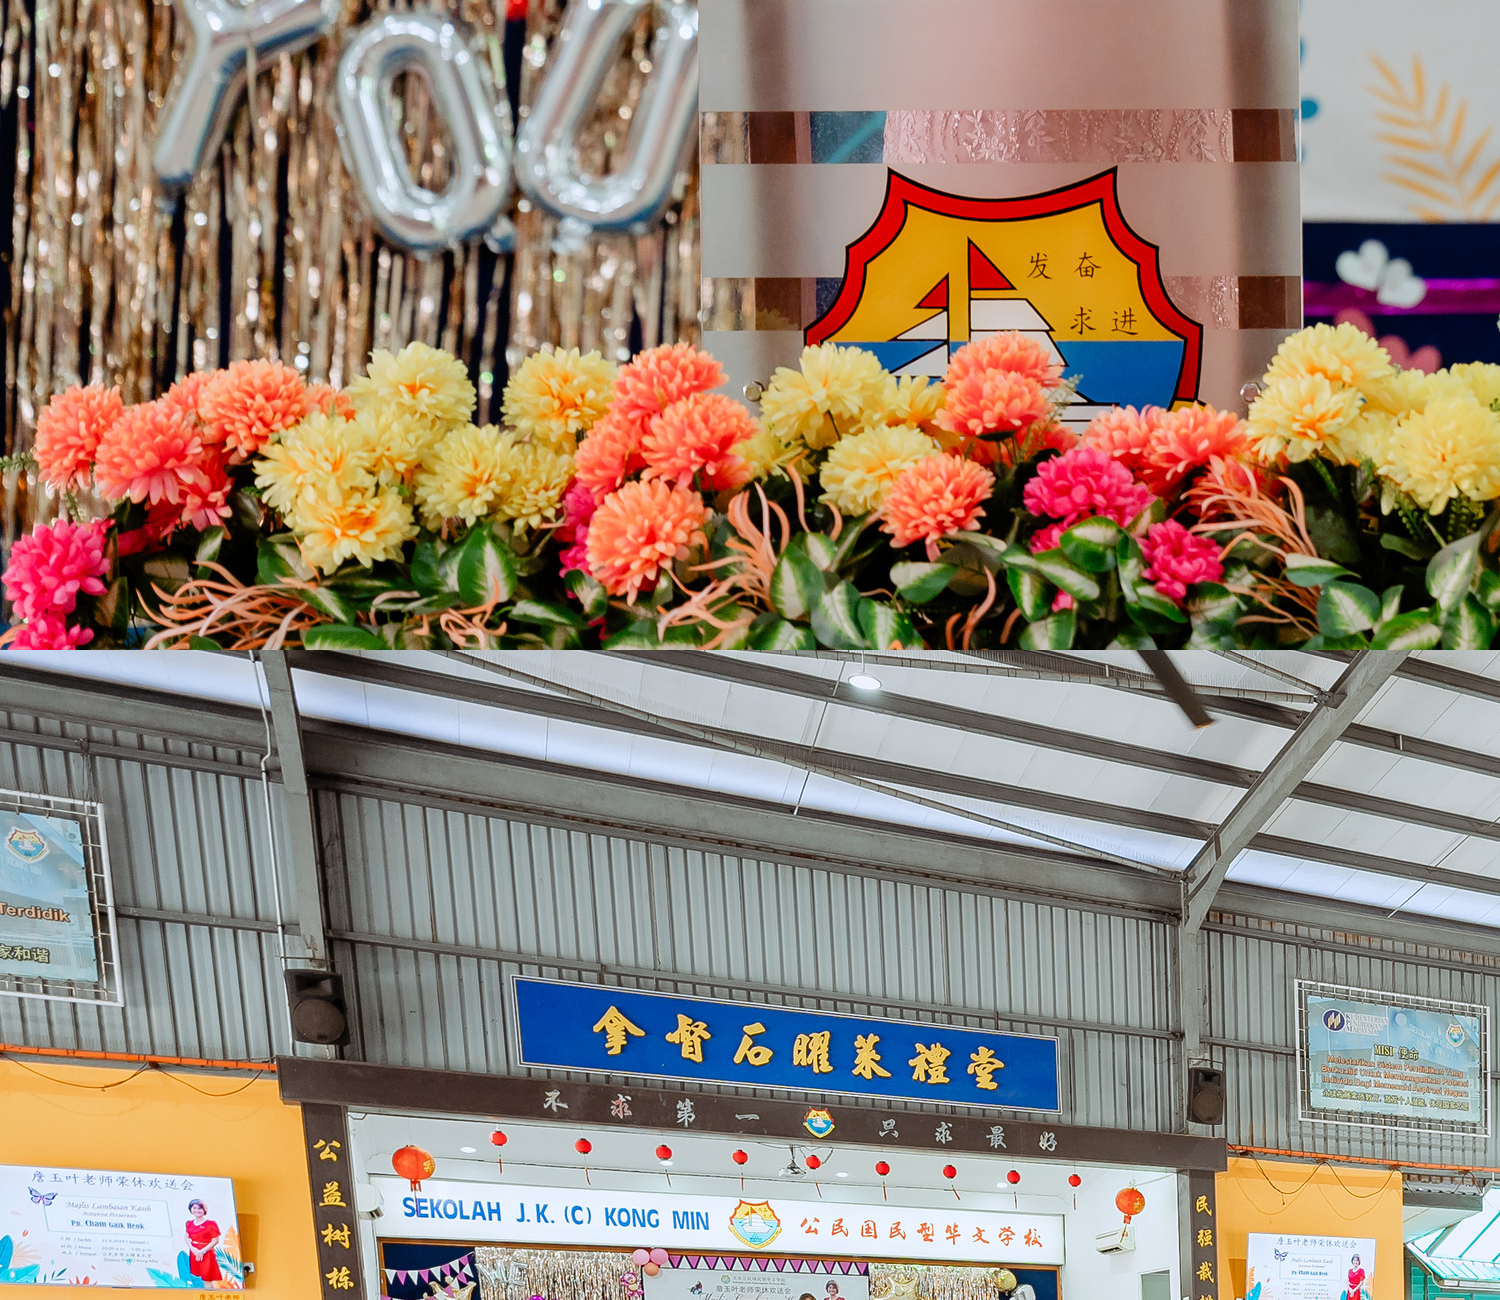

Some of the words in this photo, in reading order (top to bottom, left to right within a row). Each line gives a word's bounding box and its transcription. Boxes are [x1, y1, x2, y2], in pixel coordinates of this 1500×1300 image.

[1026, 250, 1103, 282] 发奋
[1069, 307, 1139, 338] 求进
[1374, 1044, 1394, 1057] MISI
[1398, 1046, 1419, 1061] 使命
[1377, 1061, 1402, 1070] Sistem
[542, 1088, 761, 1129] 不求第一
[878, 1118, 1060, 1153] 只求最好
[85, 1219, 107, 1228] Cham
[108, 1221, 125, 1229] Gaik
[402, 1196, 502, 1222] SEKOLAH
[564, 1205, 592, 1225] (C)
[605, 1207, 660, 1228] KONG
[672, 1209, 710, 1231] MIN
[799, 1216, 1044, 1248] 公民国民型华文学校
